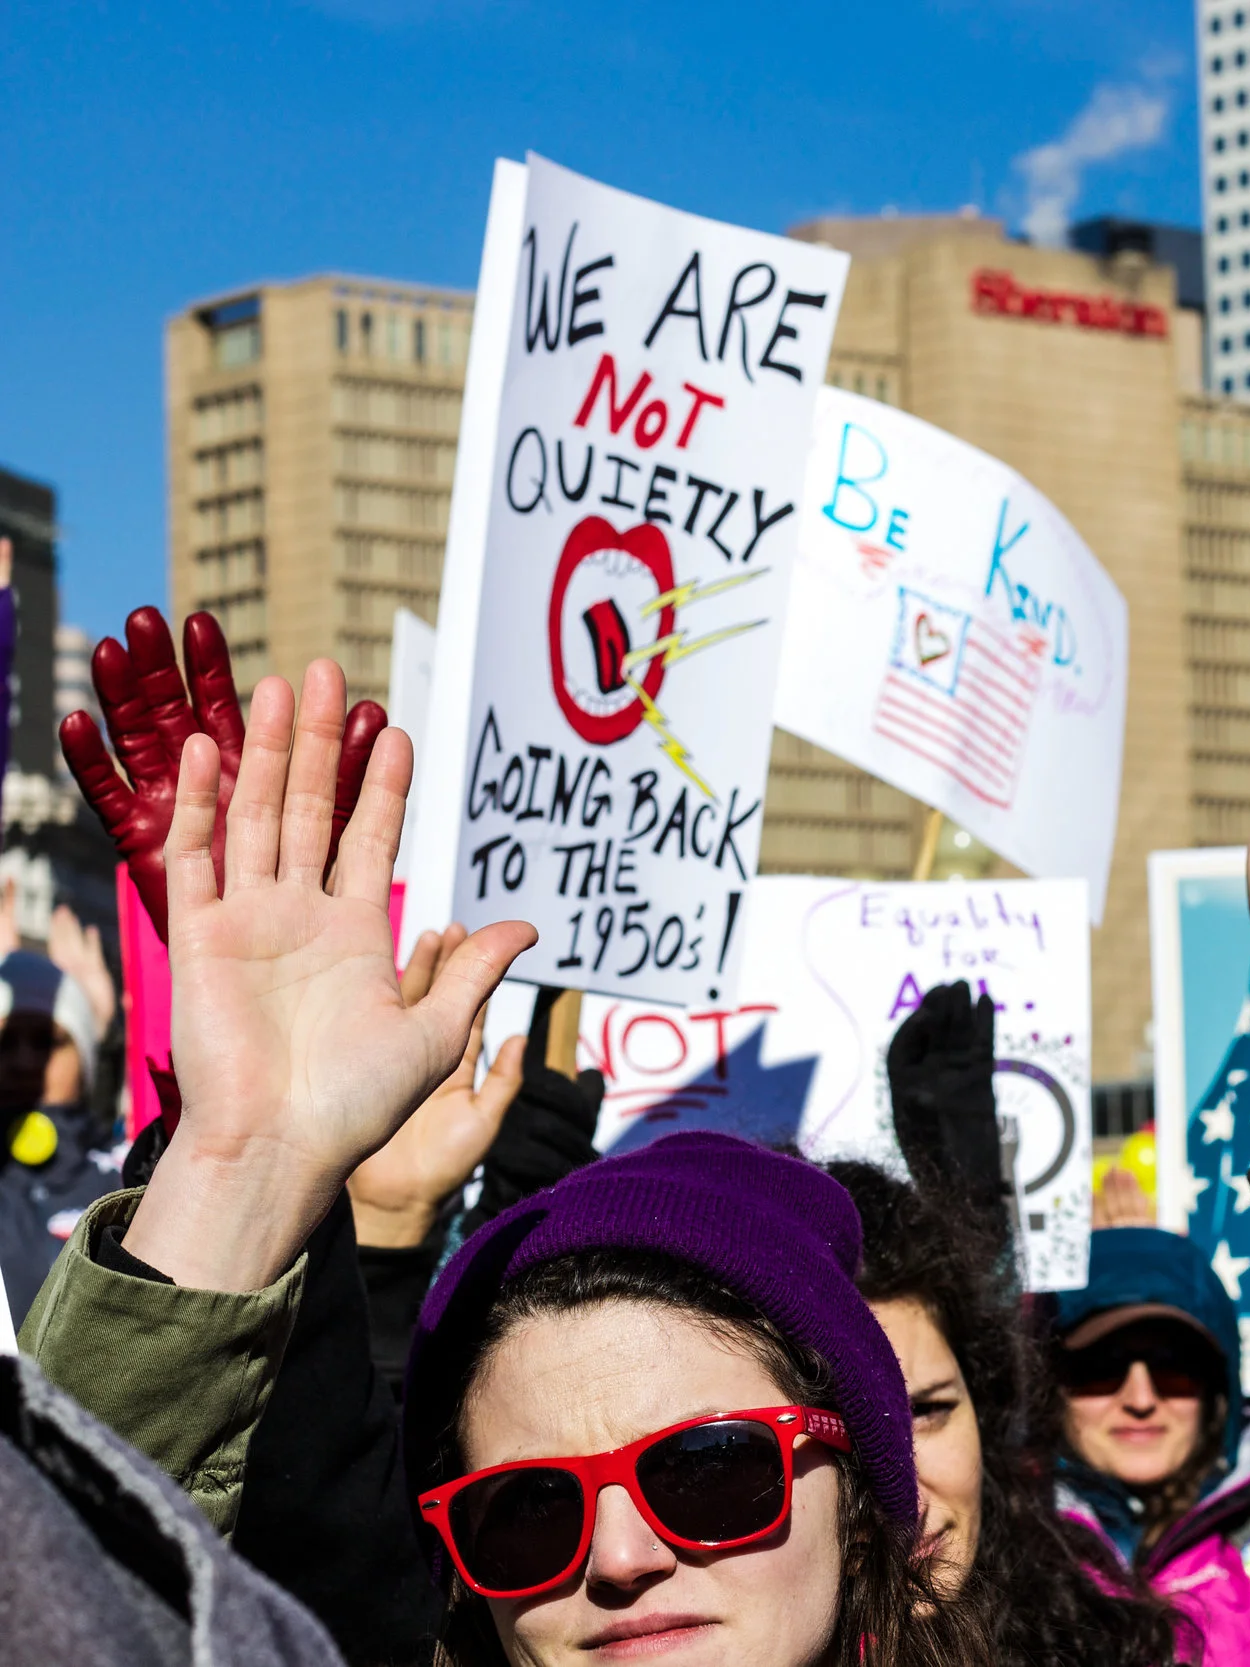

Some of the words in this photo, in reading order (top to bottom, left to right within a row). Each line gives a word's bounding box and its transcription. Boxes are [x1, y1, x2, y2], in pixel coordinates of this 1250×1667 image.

[522, 221, 614, 354] WE
[643, 250, 828, 384] ARE
[506, 427, 794, 562] QUIETLY
[467, 704, 613, 828] GOING
[624, 769, 761, 882] BACK
[470, 834, 527, 899] TO
[551, 838, 639, 899] THE
[576, 1002, 779, 1081] NOT
